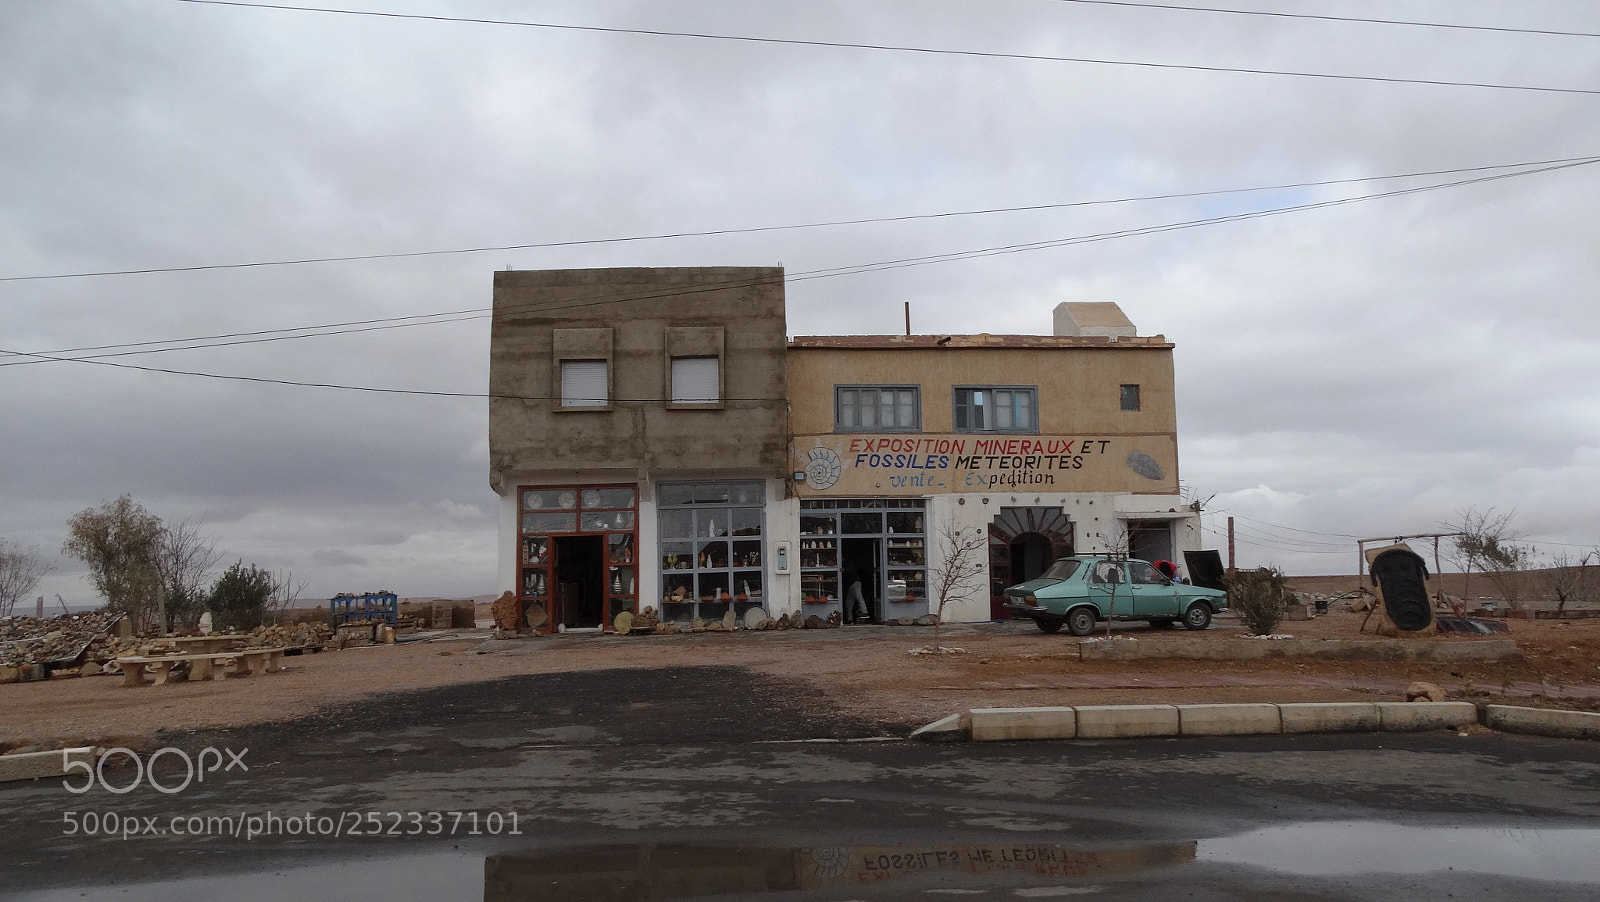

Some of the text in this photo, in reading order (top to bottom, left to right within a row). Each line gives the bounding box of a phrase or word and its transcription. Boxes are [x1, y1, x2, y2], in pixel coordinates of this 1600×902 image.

[849, 438, 1111, 455] EXPOSITION MINERAUX ET
[854, 453, 1084, 469] FOSSILES METEORITES
